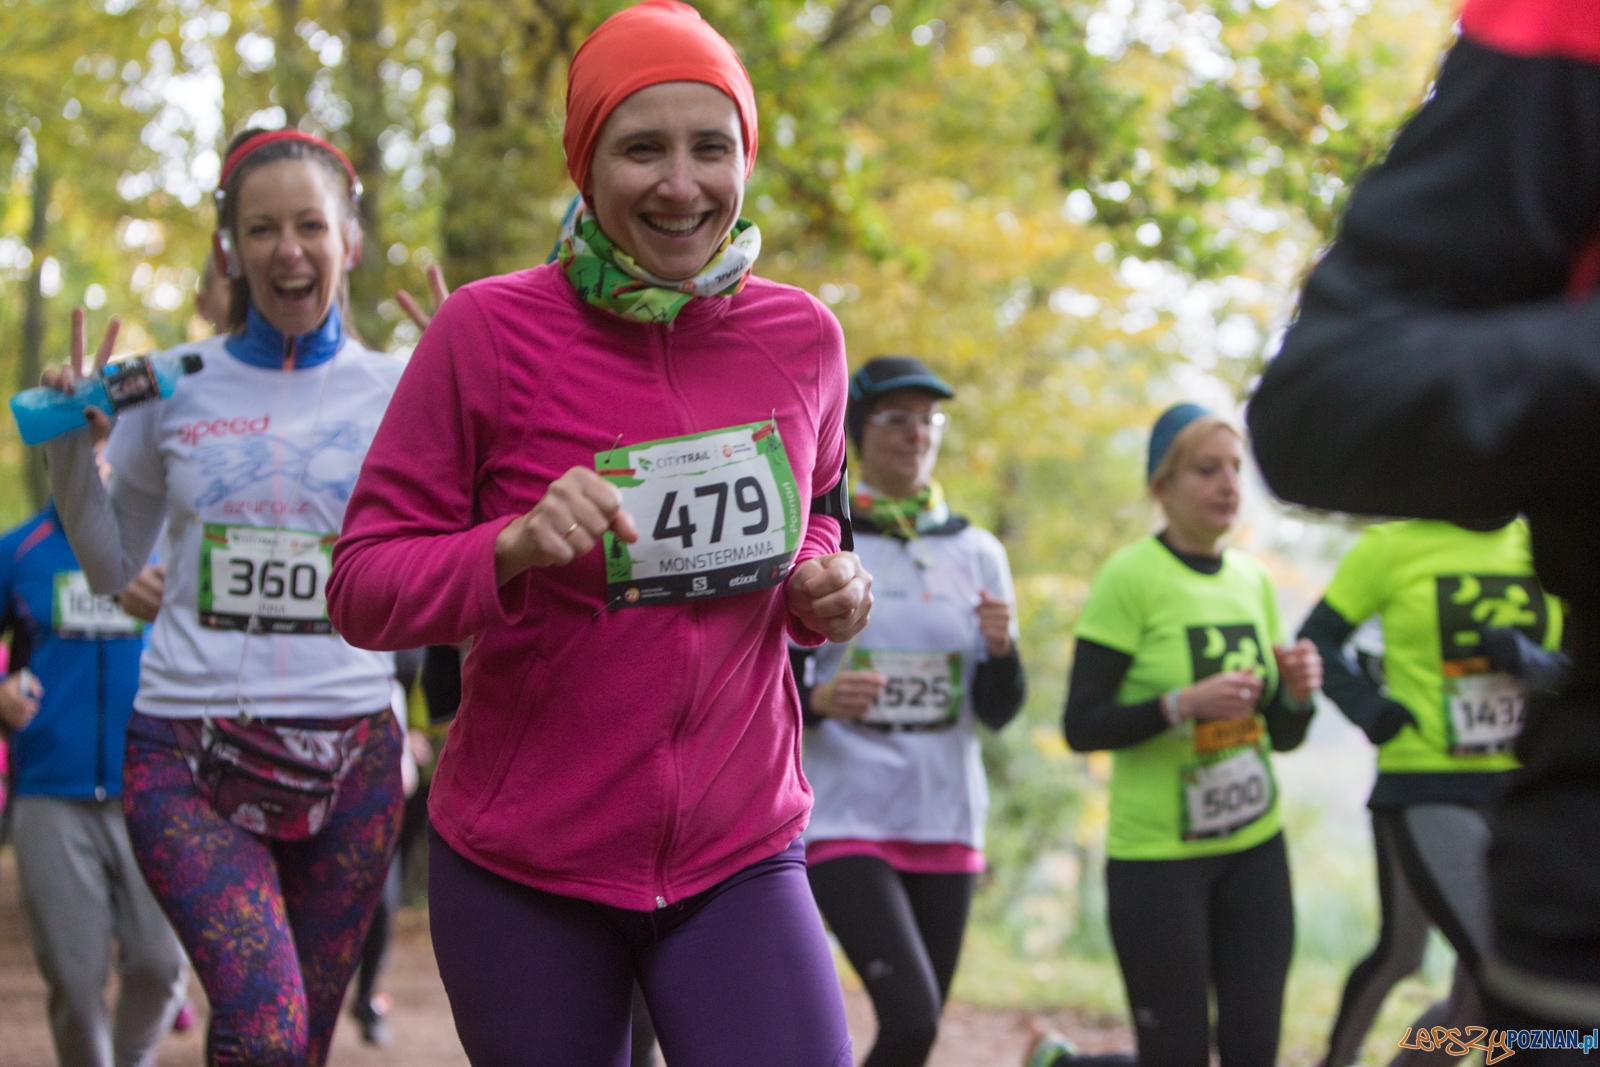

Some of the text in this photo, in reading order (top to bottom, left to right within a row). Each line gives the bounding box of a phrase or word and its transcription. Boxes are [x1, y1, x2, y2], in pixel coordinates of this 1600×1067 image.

[177, 413, 271, 447] speed
[655, 451, 711, 469] CITYTRAIL
[652, 476, 770, 549] 479
[659, 540, 774, 573] MONSTERMAMA
[228, 558, 317, 600] 360
[873, 676, 950, 708] 525
[1203, 774, 1264, 819] 500
